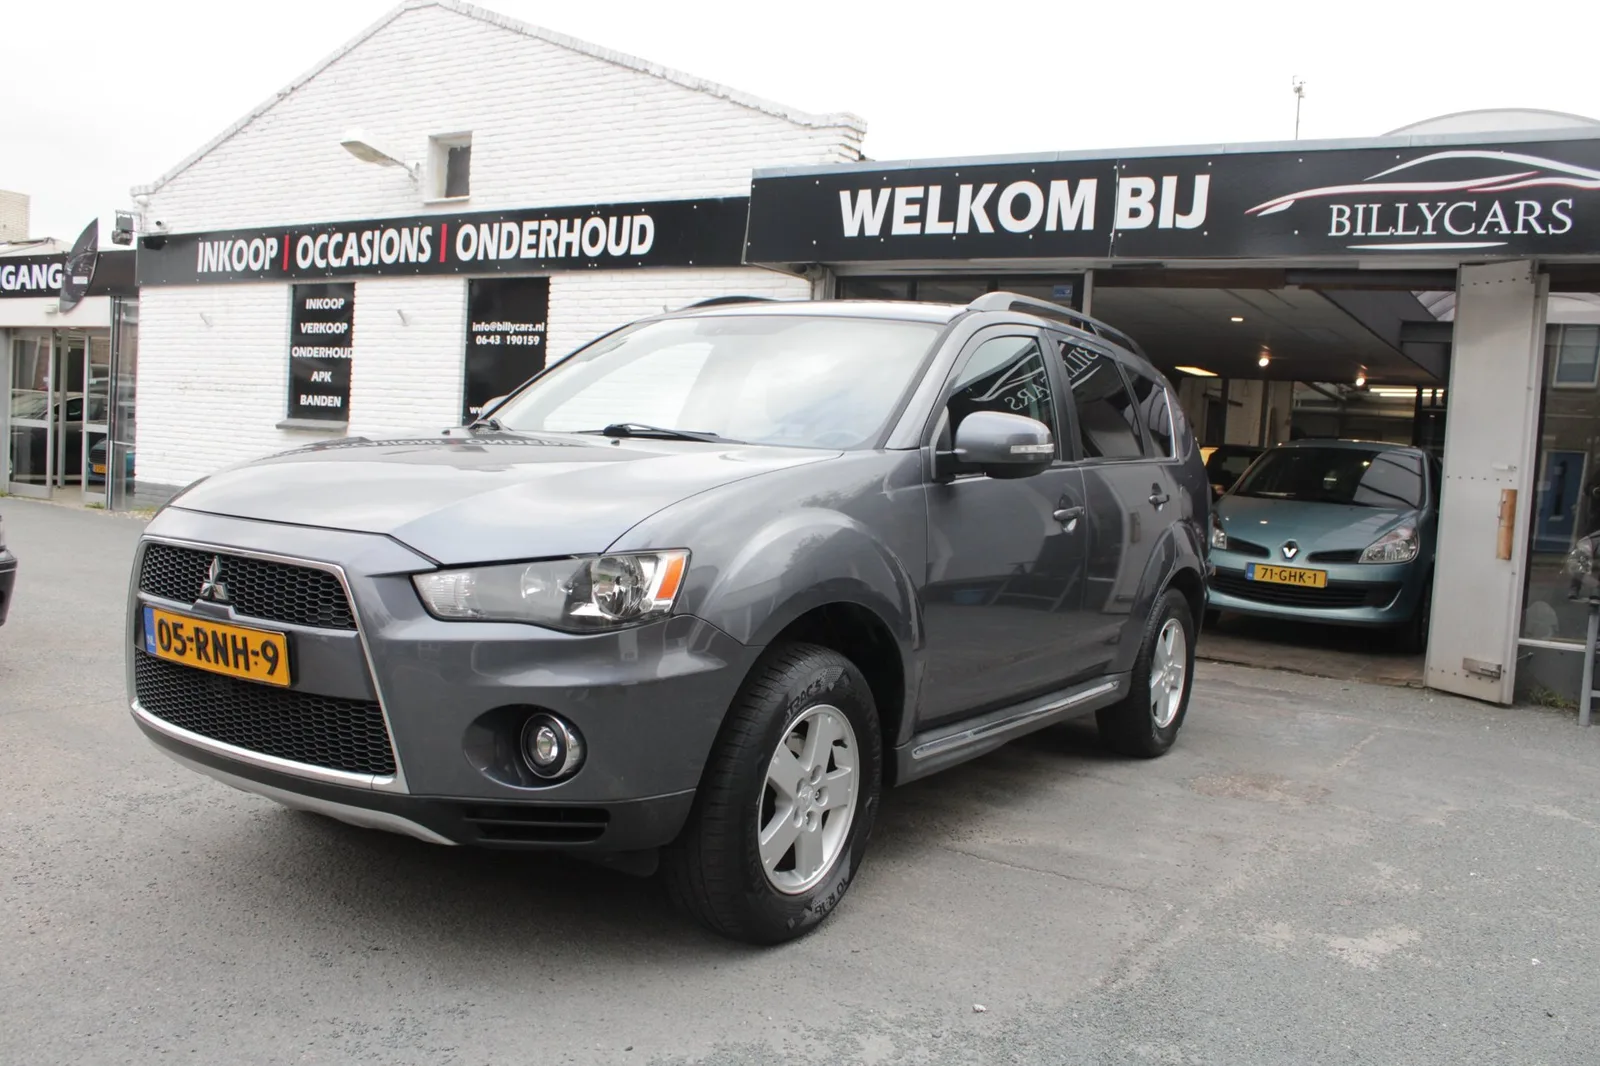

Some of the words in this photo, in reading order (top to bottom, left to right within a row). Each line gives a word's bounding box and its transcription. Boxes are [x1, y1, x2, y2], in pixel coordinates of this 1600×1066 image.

[838, 177, 1098, 238] WELKOM
[1114, 173, 1211, 231] BIJ
[1328, 198, 1573, 237] BILLYCARS
[196, 236, 278, 273] INKOOP
[295, 225, 433, 270] OCCASIONS
[454, 213, 655, 262] ONDERHOUD
[0, 262, 63, 291] GANG
[305, 298, 345, 310] INKOOP
[300, 322, 349, 334] VERKOOP
[472, 321, 545, 334] info@billycars.nl
[506, 334, 540, 346] 190159
[291, 346, 353, 359] ONDERHOUD
[310, 370, 332, 383] APK
[300, 394, 342, 408] BANDEN
[1260, 567, 1317, 585] 71-GHK-1
[157, 618, 279, 676] 05-RNH-9
